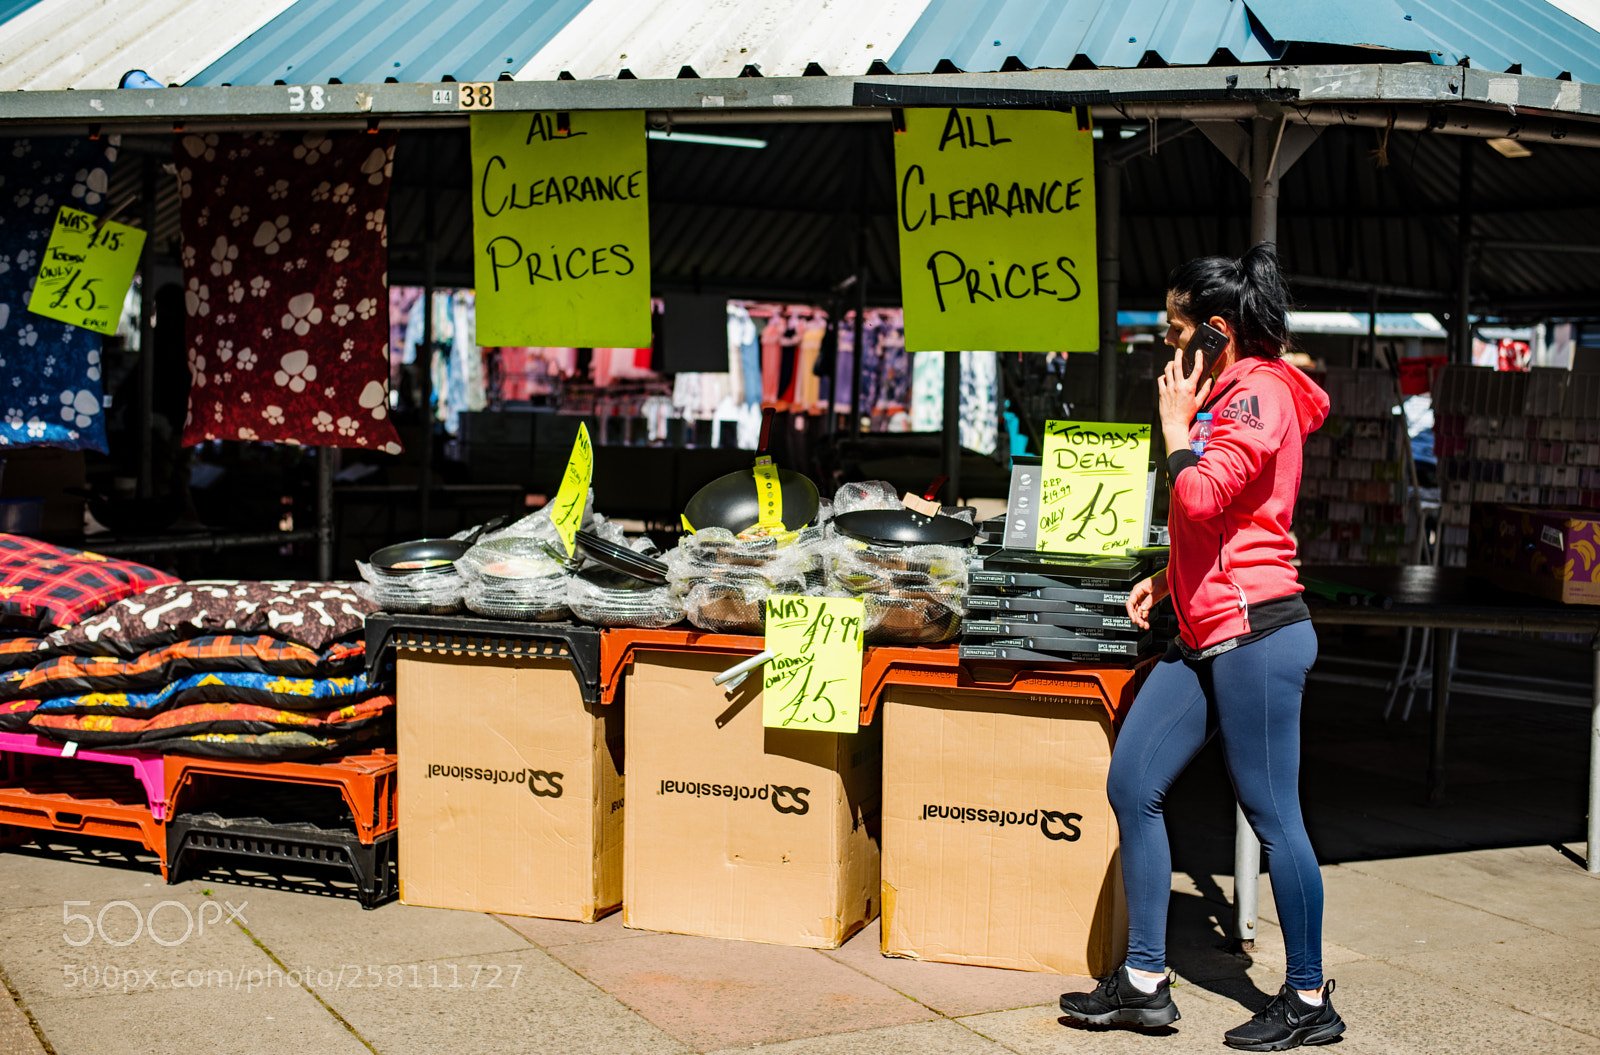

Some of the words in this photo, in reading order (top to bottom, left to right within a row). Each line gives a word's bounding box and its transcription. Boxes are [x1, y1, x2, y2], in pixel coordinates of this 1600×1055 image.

[287, 85, 325, 112] 38
[461, 85, 493, 108] 38
[938, 107, 1012, 151] ALL
[481, 154, 643, 218] CLEARANCE
[901, 164, 1084, 232] CLEARANCE
[58, 210, 89, 231] WAS
[40, 266, 73, 280] ONLY
[486, 235, 635, 292] PRICES
[926, 250, 1081, 313] PRICES
[1221, 408, 1265, 431] adidas
[1052, 448, 1125, 470] DEAL
[1043, 477, 1062, 489] RRP
[1040, 507, 1065, 530] ONLY
[767, 599, 809, 620] WAS
[769, 652, 815, 671] TODAY
[765, 668, 799, 690] ONLY
[428, 764, 526, 784] professional
[527, 768, 564, 798] SQ
[660, 780, 769, 801] professional
[771, 784, 811, 816] SQ
[922, 804, 1038, 827] professional
[1040, 809, 1083, 842] SQ
